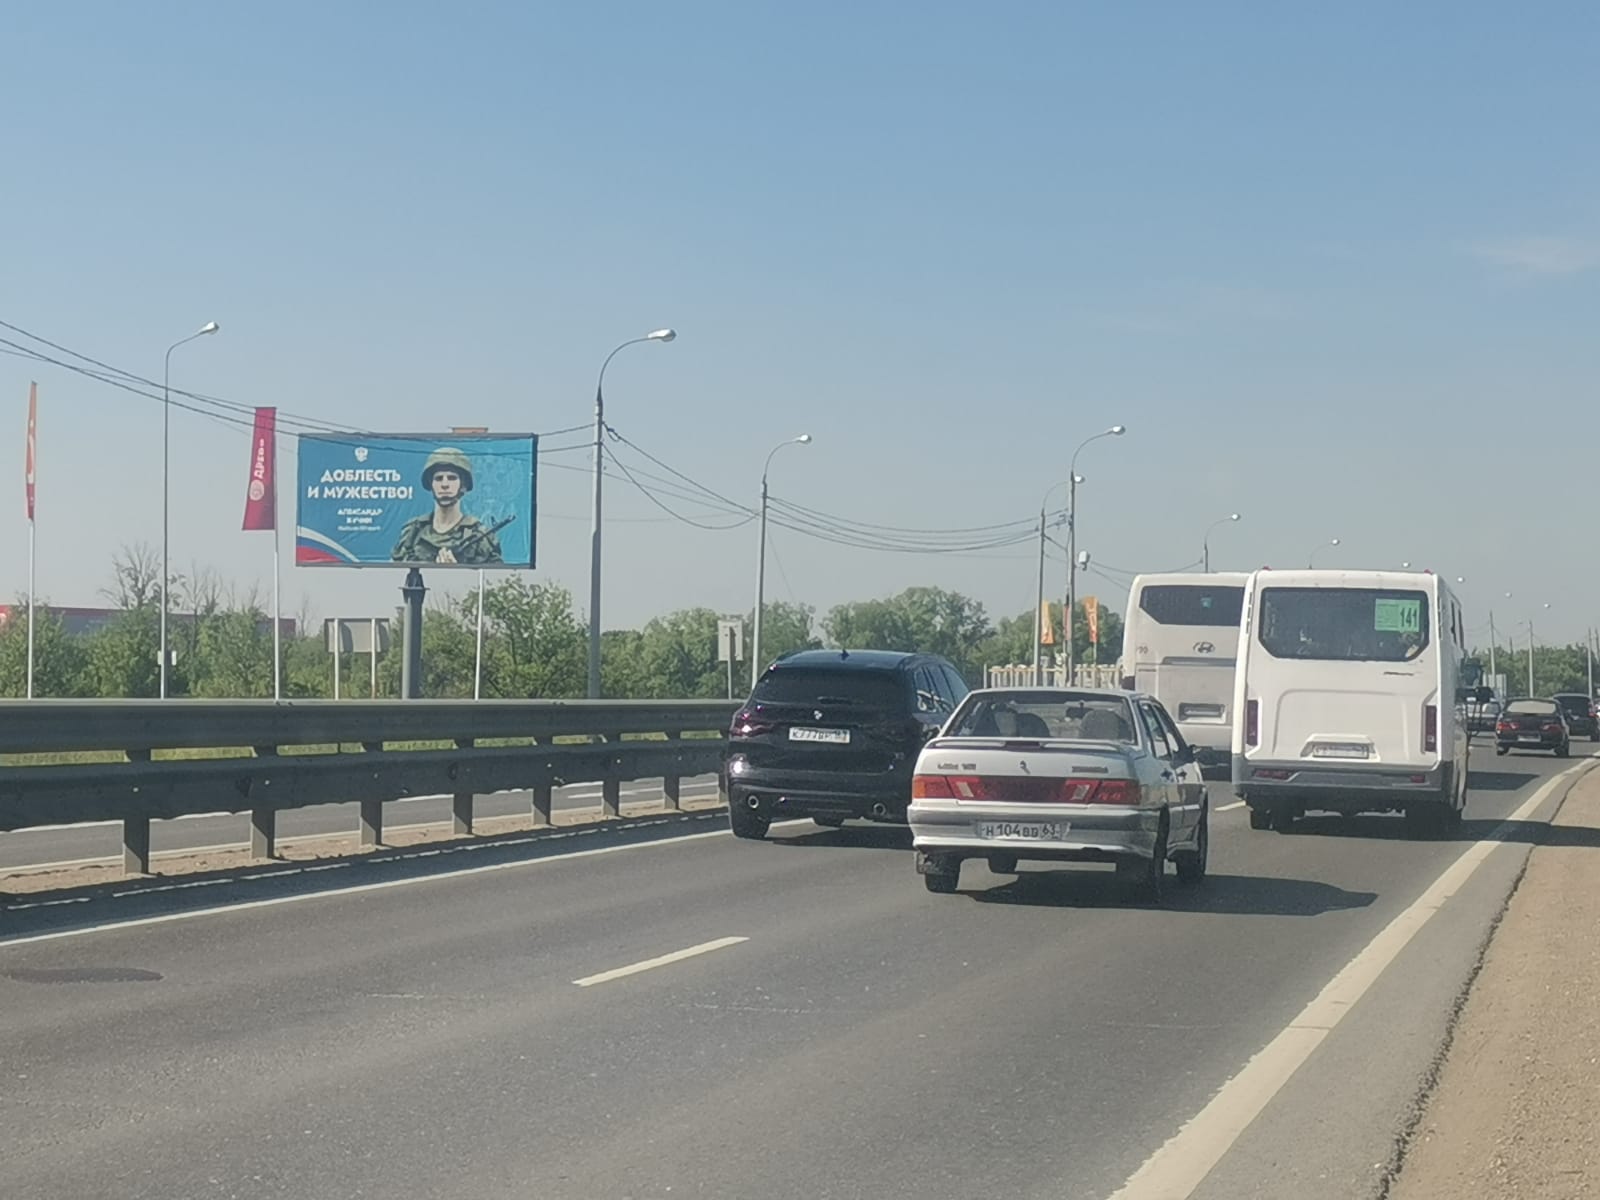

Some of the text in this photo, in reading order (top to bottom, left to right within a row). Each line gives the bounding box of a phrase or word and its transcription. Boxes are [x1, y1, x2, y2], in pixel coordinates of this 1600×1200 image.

[320, 469, 401, 483] ДОБЛЕСТЬ
[307, 486, 413, 500] И МУЖЕСТВО!
[1400, 607, 1417, 628] 141
